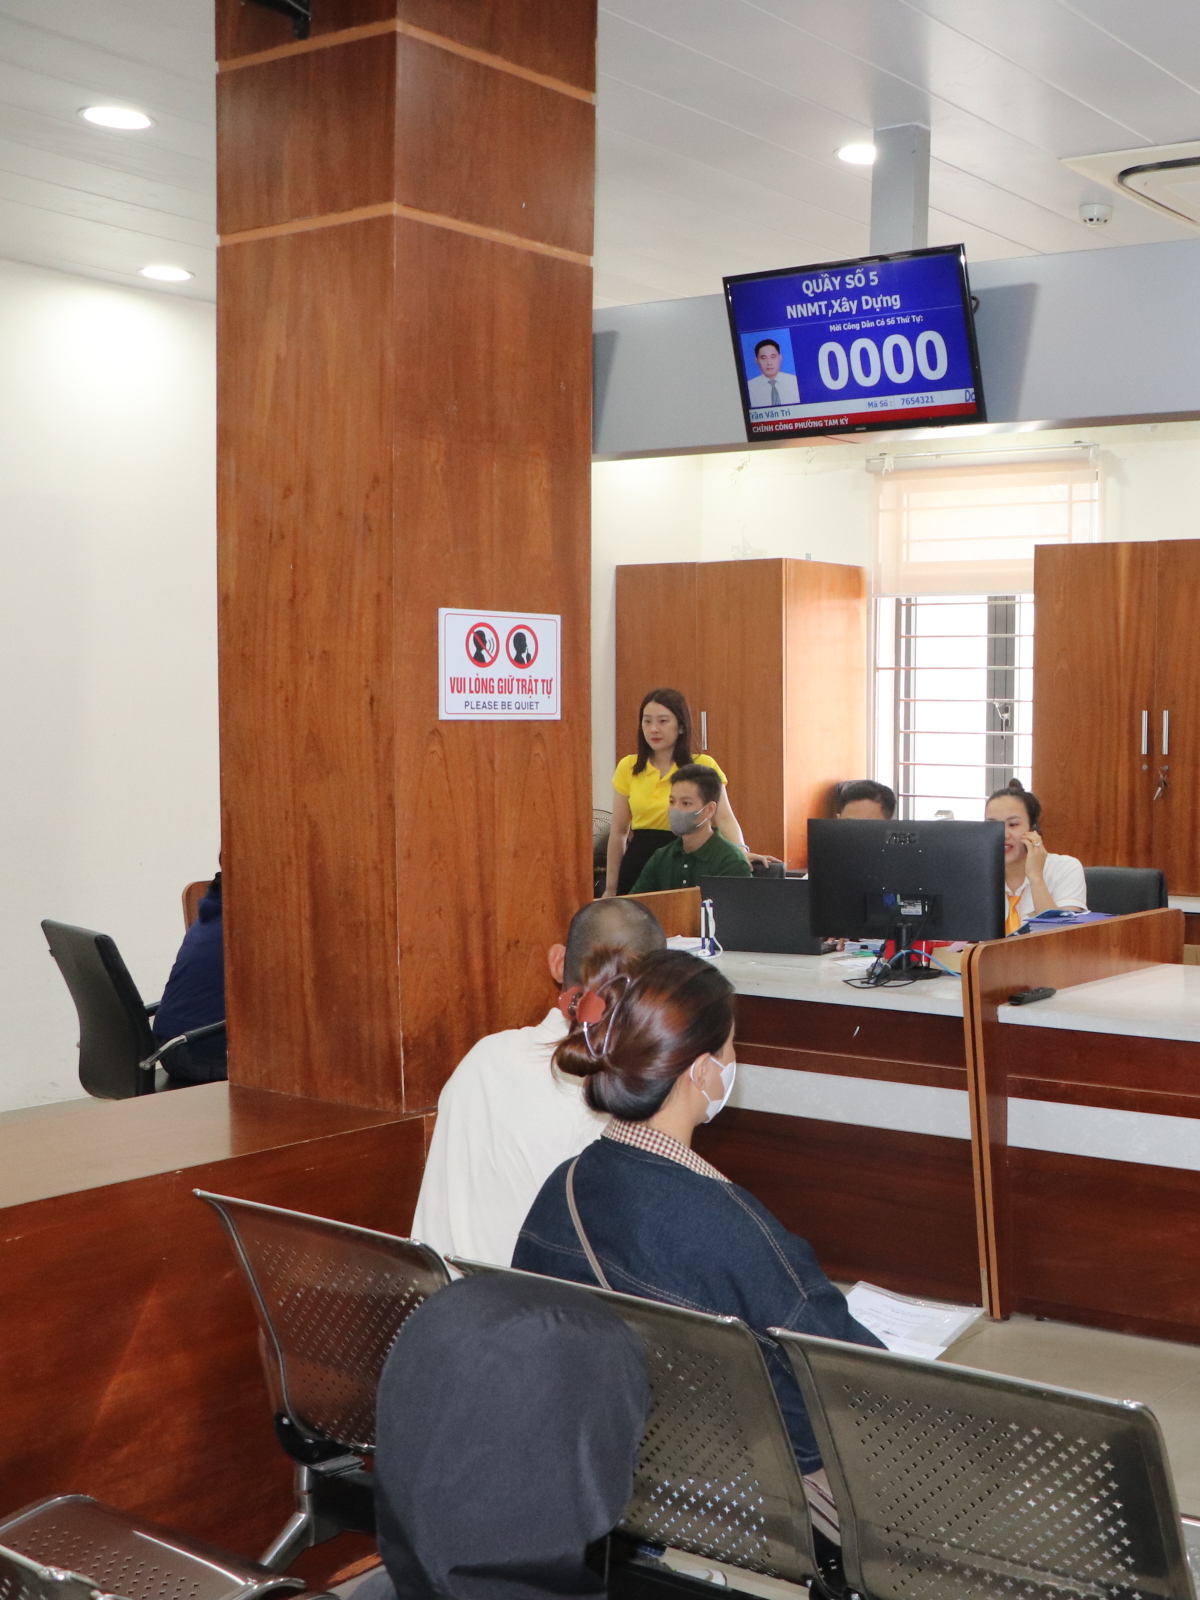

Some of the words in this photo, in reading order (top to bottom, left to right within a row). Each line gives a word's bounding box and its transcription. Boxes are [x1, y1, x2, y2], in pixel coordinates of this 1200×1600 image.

[802, 273, 841, 297] QUẦY
[845, 268, 866, 289] SỐ
[869, 271, 879, 286] 5
[786, 297, 858, 319] NNMT,Xây
[861, 294, 901, 312] Dựng
[829, 324, 842, 332] Mời
[843, 321, 860, 331] Công
[861, 319, 875, 329] Dân
[876, 318, 886, 326] Có
[886, 317, 895, 325] Số
[896, 315, 910, 324] Thứ
[818, 330, 948, 391] 0000
[901, 396, 934, 405] 7654321
[752, 423, 774, 433] CHÍNH
[775, 421, 793, 431] CÔNG
[794, 419, 823, 430] PHƯỜNG
[824, 417, 838, 427] TAM
[839, 415, 849, 425] KỲ
[449, 677, 466, 694] VUI
[468, 673, 495, 694] LÒNG
[497, 675, 514, 695] GIỮ
[516, 675, 539, 698] TRẬT
[541, 678, 553, 698] TỰ
[464, 701, 499, 710] PLEASE
[501, 701, 513, 710] BE
[514, 701, 540, 711] QUIET
